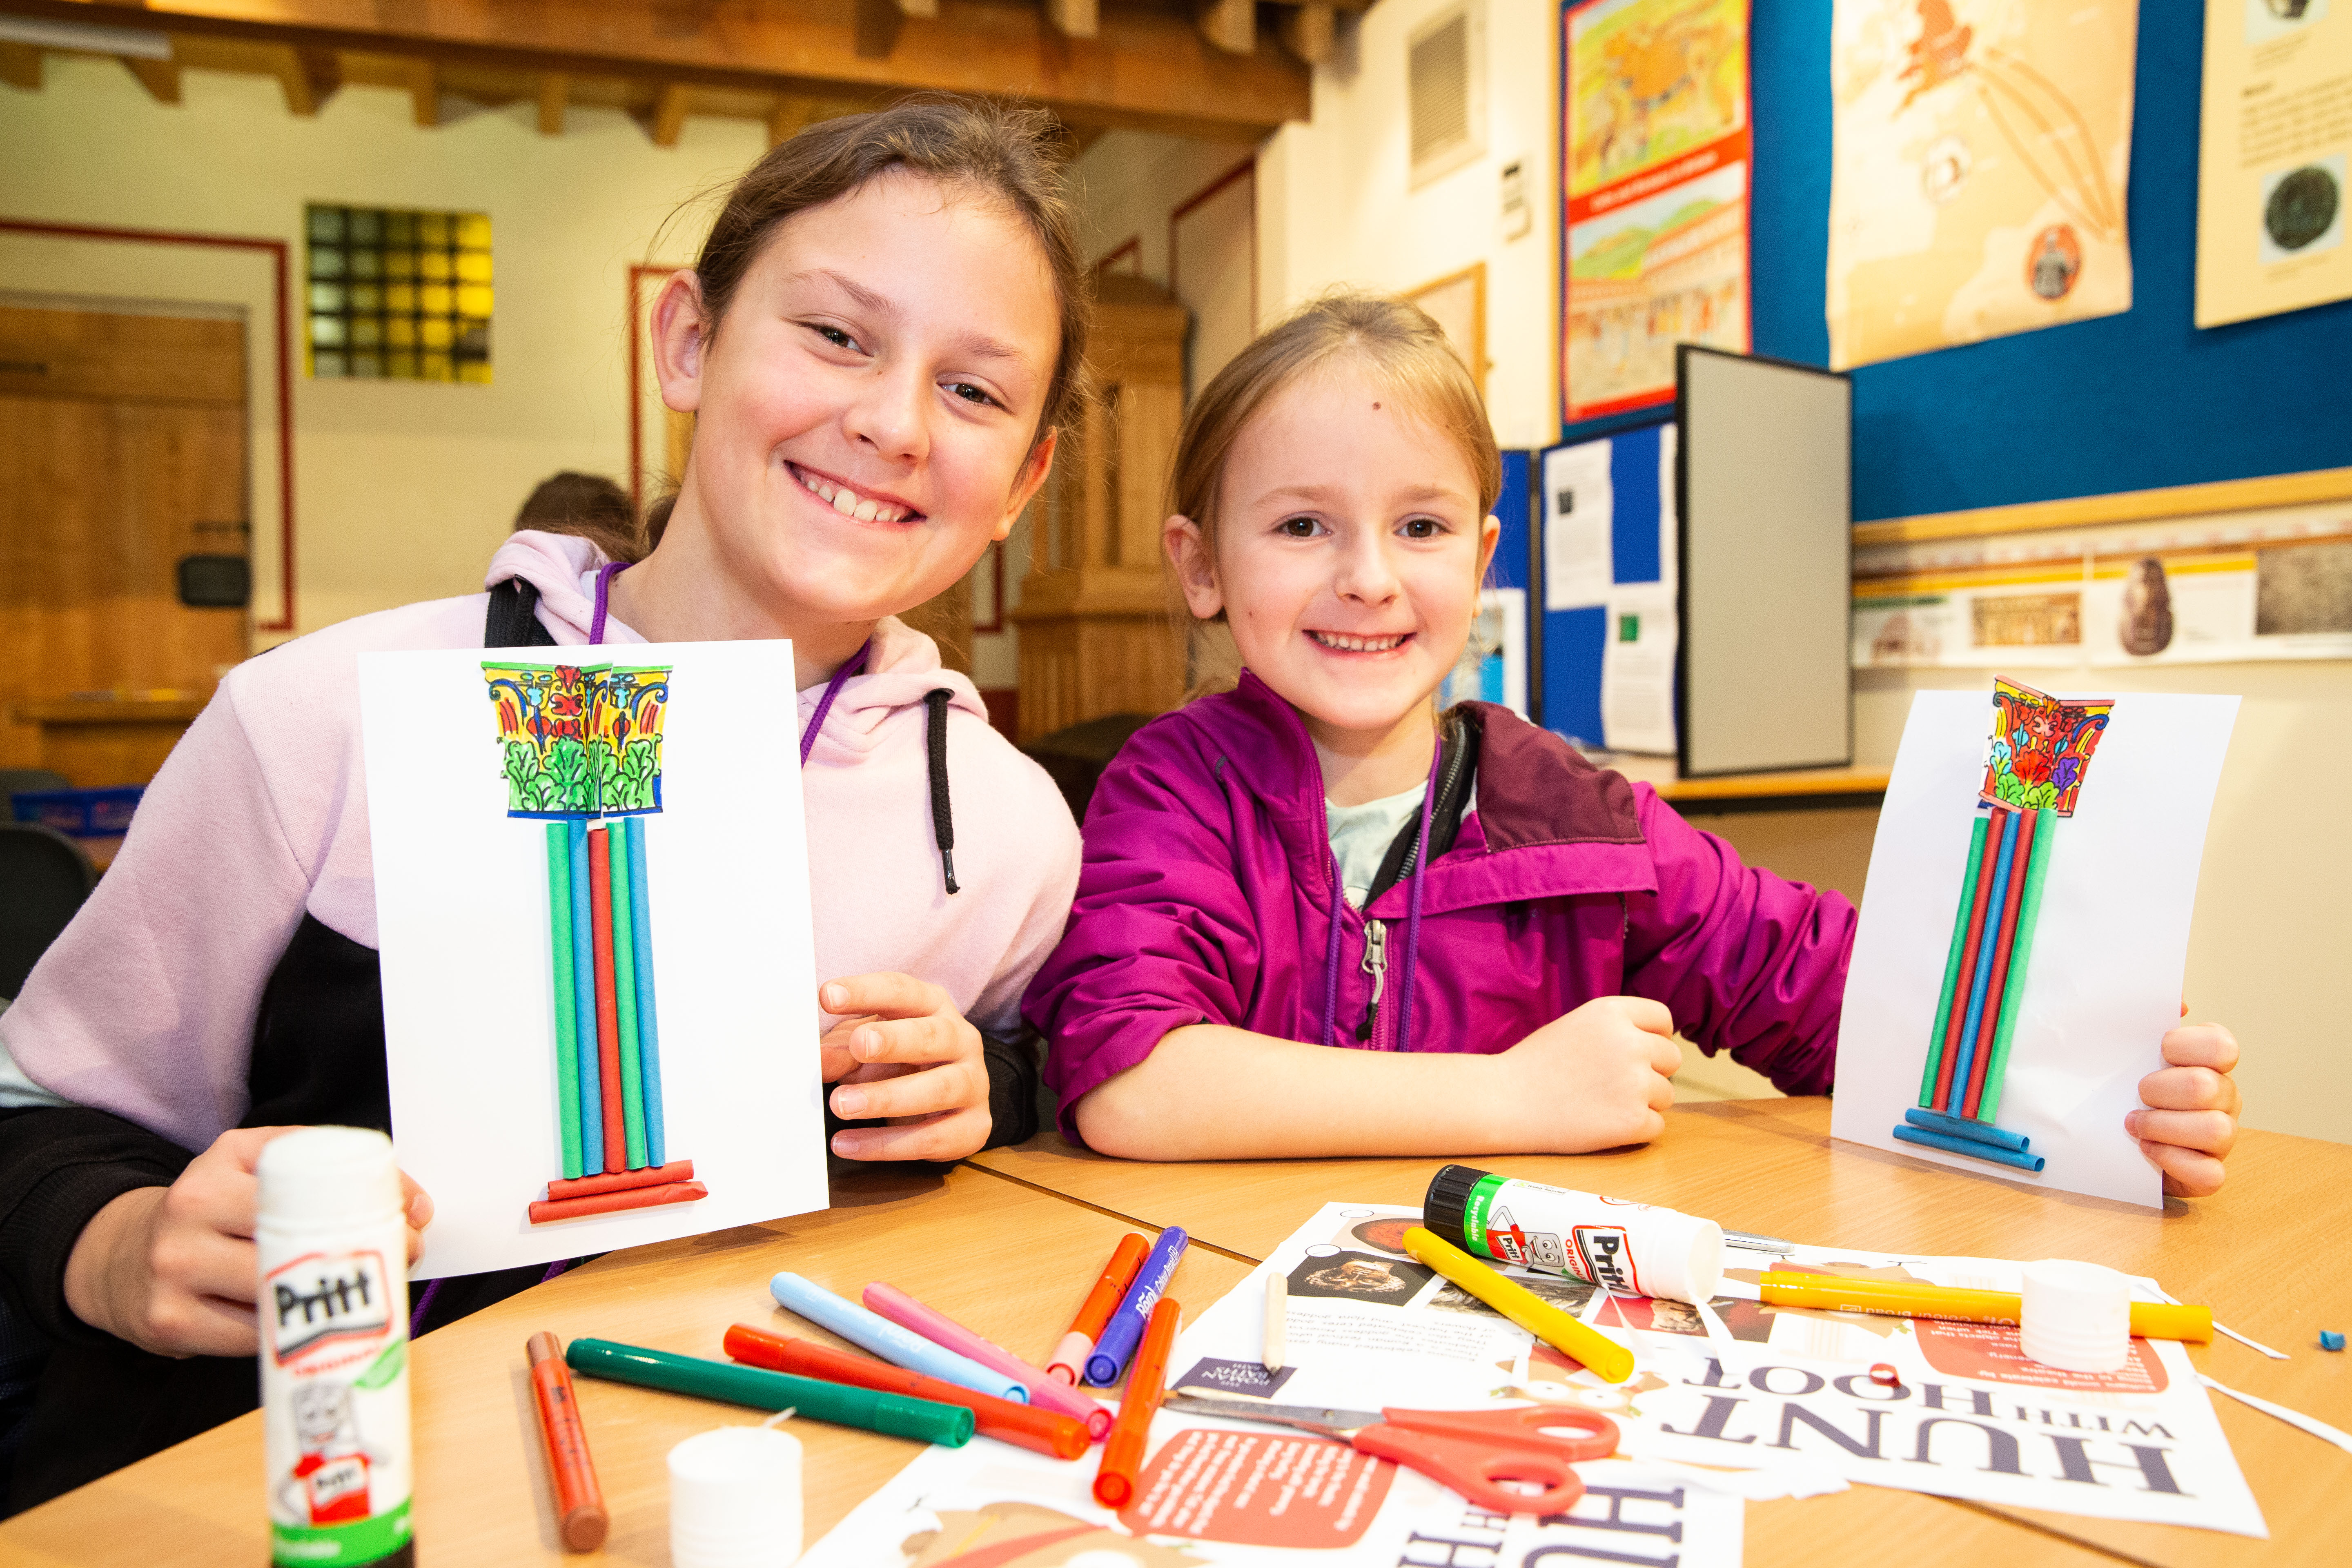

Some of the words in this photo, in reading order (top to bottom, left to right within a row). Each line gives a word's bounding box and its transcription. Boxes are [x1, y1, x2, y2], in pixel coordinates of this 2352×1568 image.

[1470, 1195, 1484, 1242] Recyclable
[1503, 1237, 1520, 1260] Pritt
[1594, 1236, 1631, 1290] Pritt
[274, 1265, 373, 1328] Pritt
[1136, 1285, 1159, 1320] Berol
[1154, 1274, 1169, 1294] Colour
[1163, 1254, 1178, 1278] Broad
[1358, 1323, 1422, 1335] celebrated
[1401, 1323, 1448, 1333] harvest
[1930, 1330, 1956, 1338] that
[1958, 1332, 2000, 1341] objects
[1354, 1343, 1420, 1352] celebrated
[1201, 1371, 1271, 1386] ROMAN
[1977, 1370, 1997, 1379] by
[1682, 1356, 2002, 1419] HOOT
[2014, 1405, 2179, 1440] WITH
[1660, 1394, 2196, 1497] HUNT
